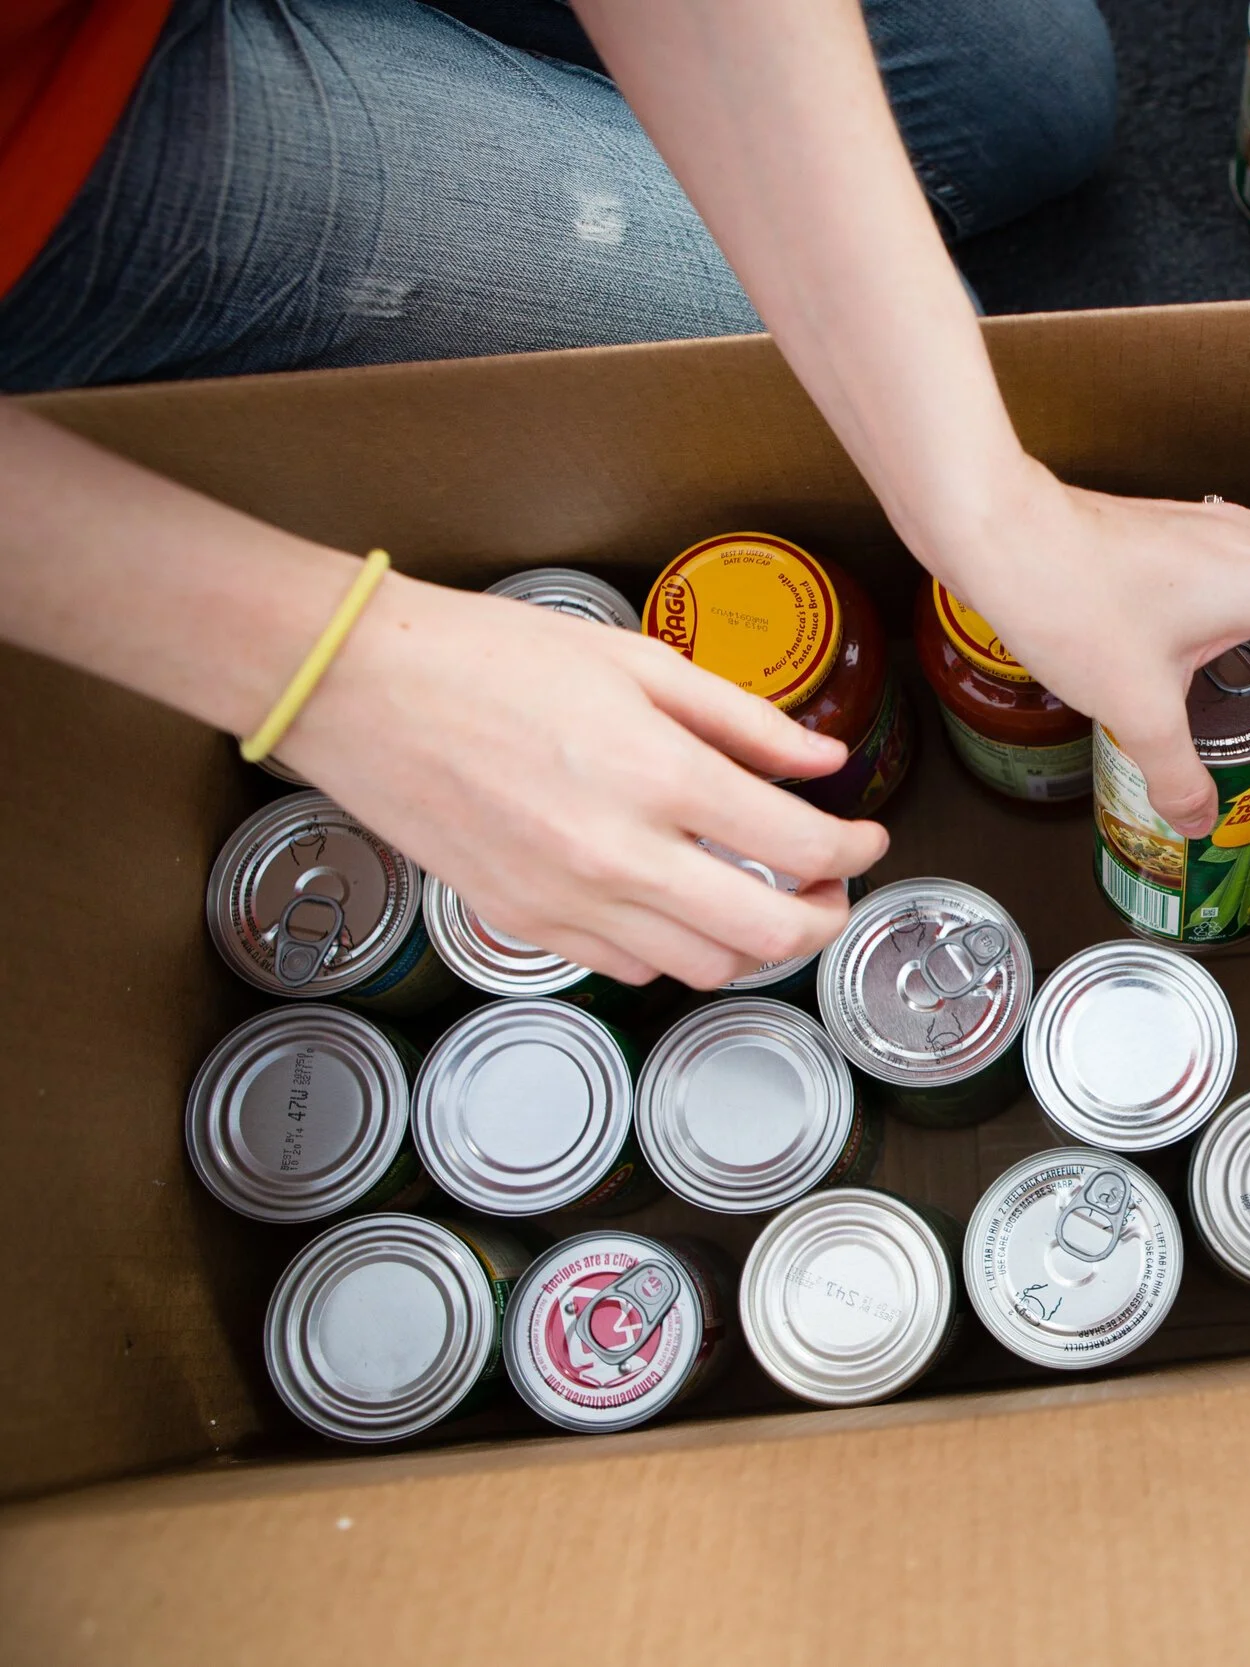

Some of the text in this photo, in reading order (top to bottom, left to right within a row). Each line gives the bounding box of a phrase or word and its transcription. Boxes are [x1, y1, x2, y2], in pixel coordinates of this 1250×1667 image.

[720, 552, 737, 560] BEST
[745, 550, 764, 558] USED
[765, 552, 775, 560] BY
[723, 557, 741, 566] DATE
[755, 558, 771, 566] CAP
[777, 573, 803, 609] Favorite
[791, 580, 818, 669] Pasta Sauce Brand
[785, 611, 806, 659] America's
[288, 1089, 309, 1121] 47W
[296, 1128, 304, 1138] 14
[280, 1131, 295, 1171] BEST BY
[292, 1144, 302, 1155] 20
[1020, 1177, 1041, 1193] BACK
[1004, 1190, 1022, 1208] PEEL
[998, 1260, 1007, 1276] USE
[1003, 1207, 1023, 1234] EDGES
[1019, 1195, 1036, 1210] MAY
[1035, 1188, 1047, 1199] BE
[986, 1236, 995, 1247] TO
[1145, 1240, 1154, 1256] USE
[1156, 1232, 1166, 1250] LIFT
[985, 1249, 993, 1263] TAB
[541, 1258, 582, 1294] Recipes
[584, 1253, 601, 1268] are
[604, 1254, 610, 1265] a
[985, 1266, 996, 1283] LIFT
[1157, 1268, 1166, 1280] TO
[1130, 1283, 1149, 1310] EDGES
[1116, 1307, 1134, 1323] MAY
[1131, 1309, 1148, 1327] PEEL
[1106, 1319, 1118, 1330] BE
[1111, 1324, 1133, 1342] BACK
